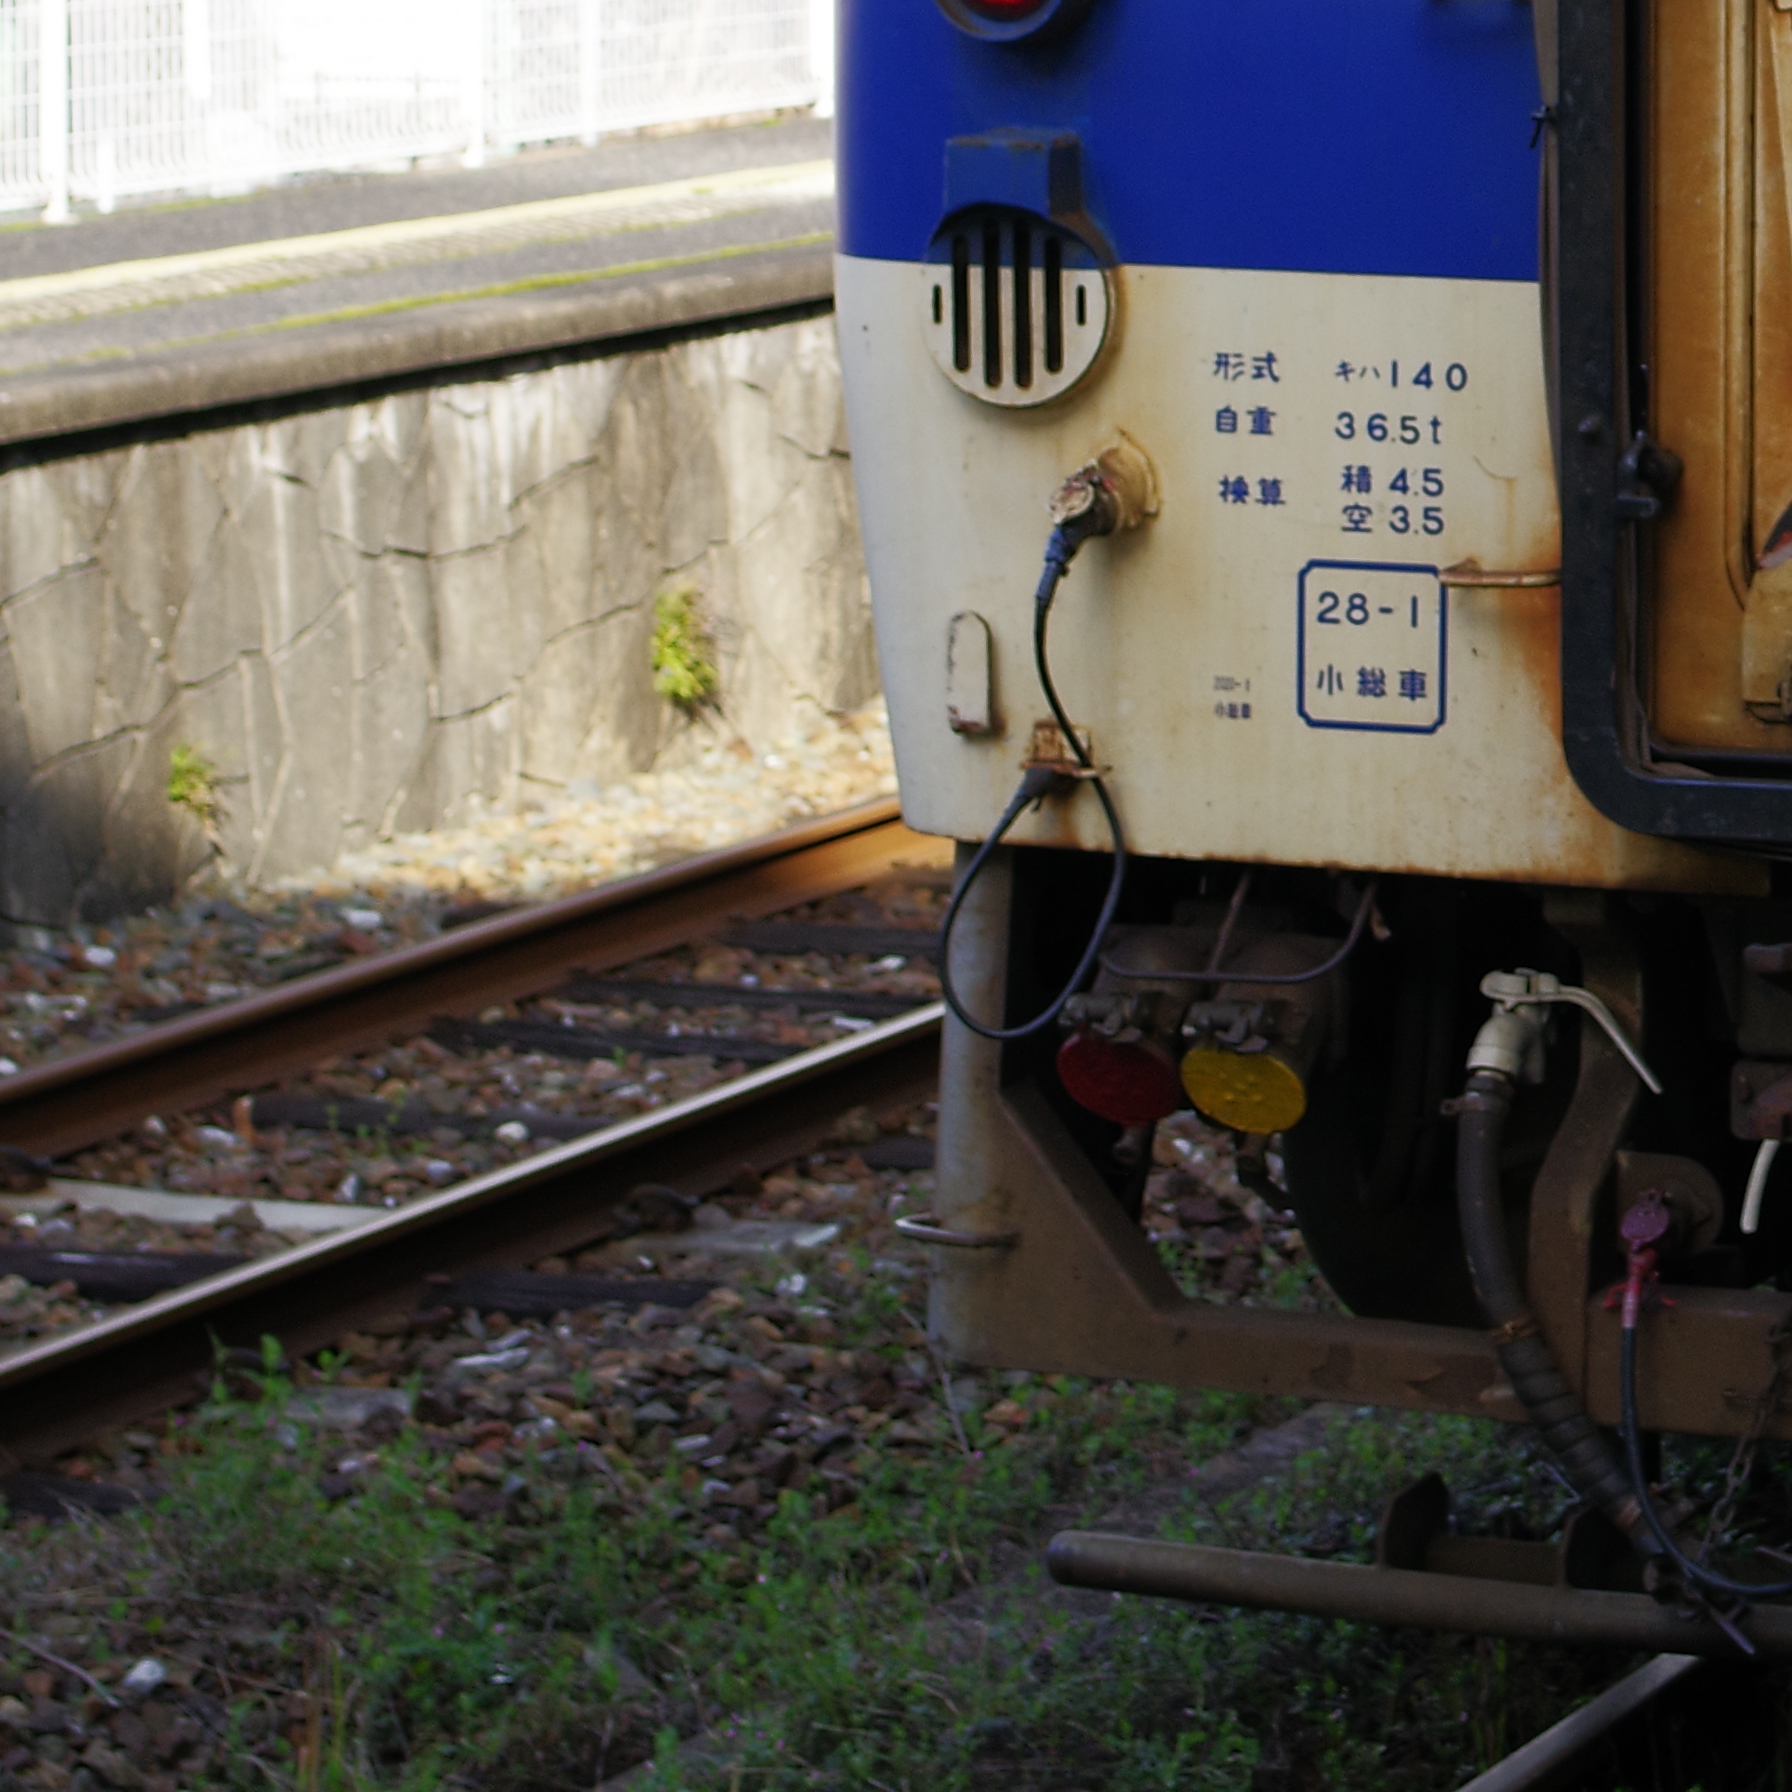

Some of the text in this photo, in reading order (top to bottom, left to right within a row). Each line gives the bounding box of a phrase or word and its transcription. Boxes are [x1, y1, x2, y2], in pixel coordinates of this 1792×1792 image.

[1213, 351, 1280, 383] 形式
[1214, 405, 1443, 445] 自重 36.5t
[1388, 468, 1445, 497] 4.5
[1341, 503, 1445, 535] 空 3.5
[1316, 591, 1421, 628] 28-1
[1315, 663, 1428, 701] 小総車
